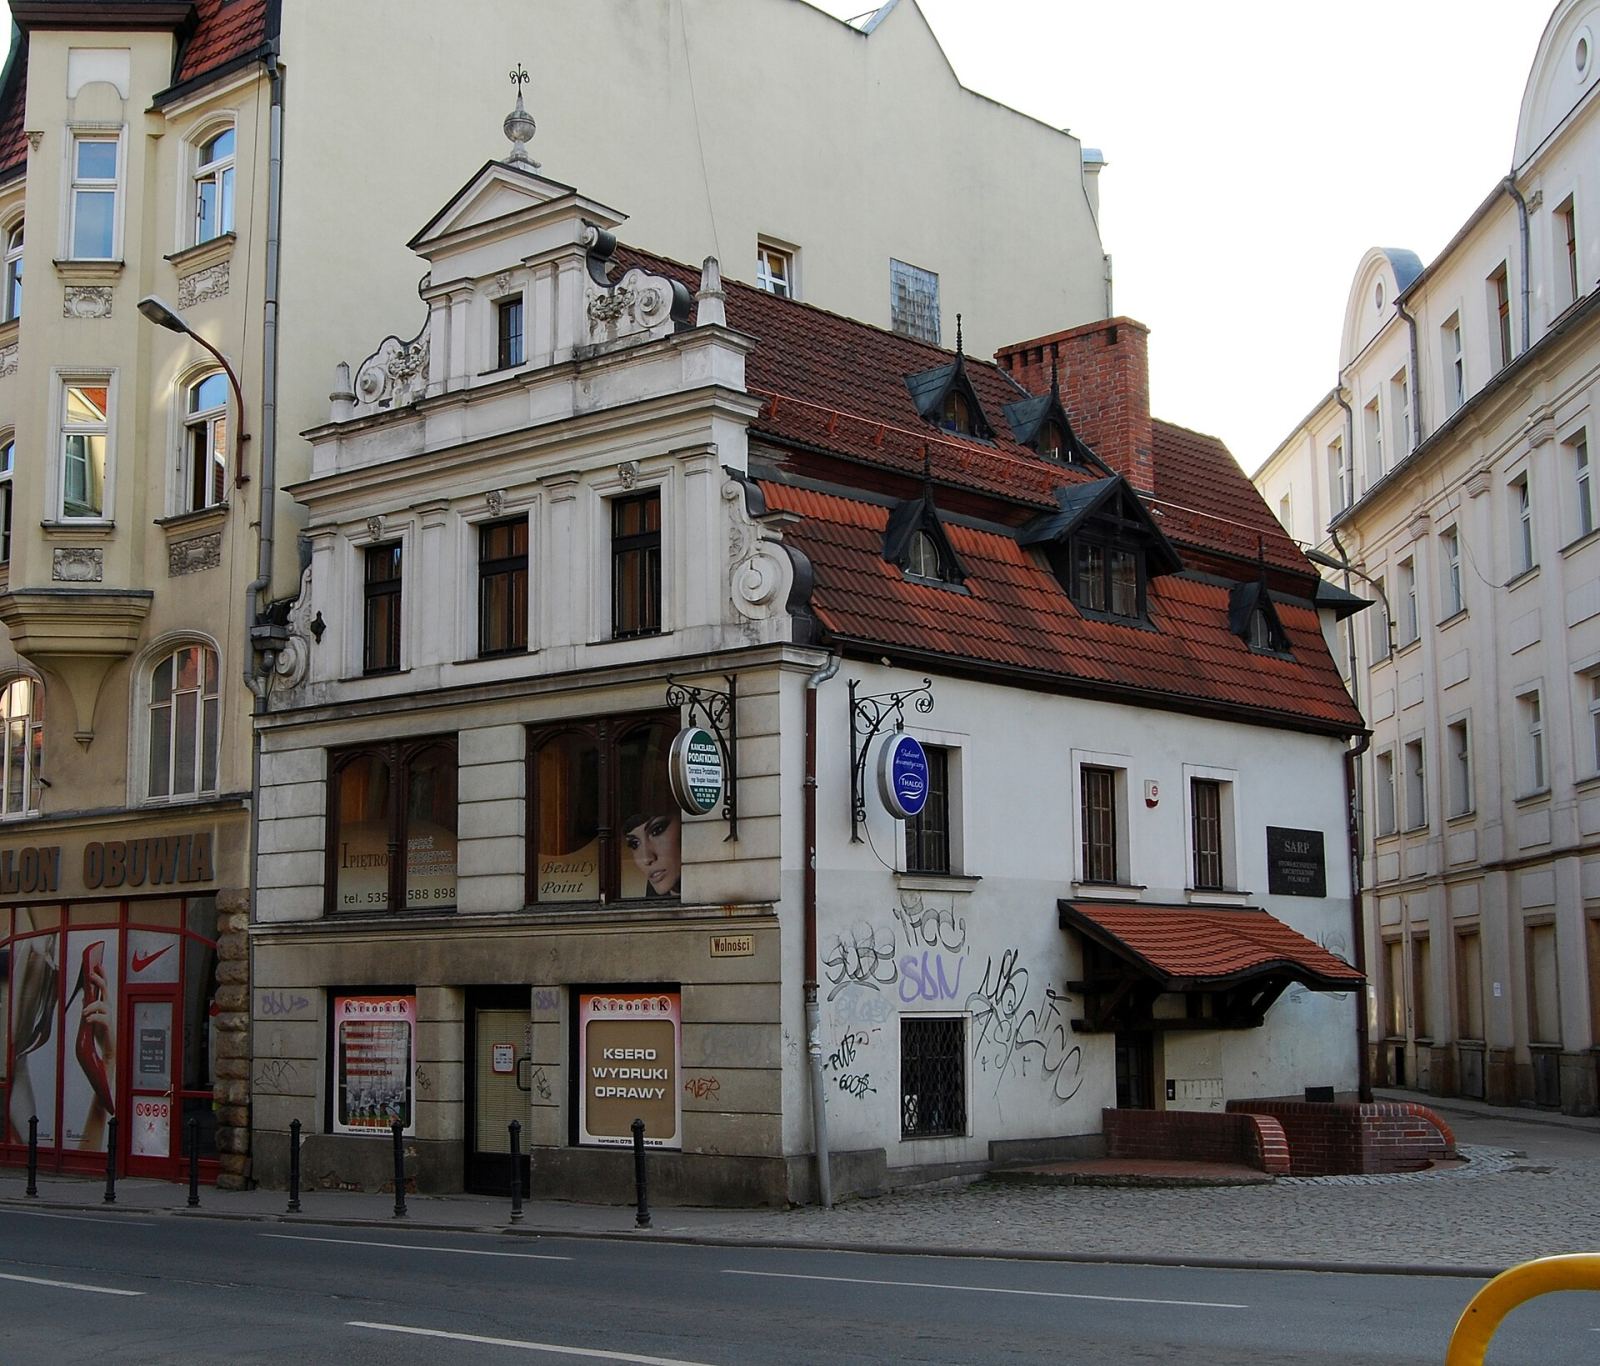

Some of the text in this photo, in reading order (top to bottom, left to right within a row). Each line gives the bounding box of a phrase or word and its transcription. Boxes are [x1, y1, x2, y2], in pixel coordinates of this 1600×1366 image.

[688, 753, 720, 763] PODATKOWA
[1284, 840, 1310, 854] SARP
[83, 833, 214, 890] OBUWIA
[350, 853, 389, 871] PIĘTRO
[541, 861, 597, 877] Beauty
[541, 880, 584, 894] Point
[344, 887, 456, 904] tel. 535 588 898
[713, 937, 750, 952] Wolności
[592, 1000, 669, 1012] KSERODRUK
[603, 1048, 657, 1060] KSERO
[592, 1067, 668, 1080] WYDRUKI
[595, 1086, 665, 1099] OPRAWY
